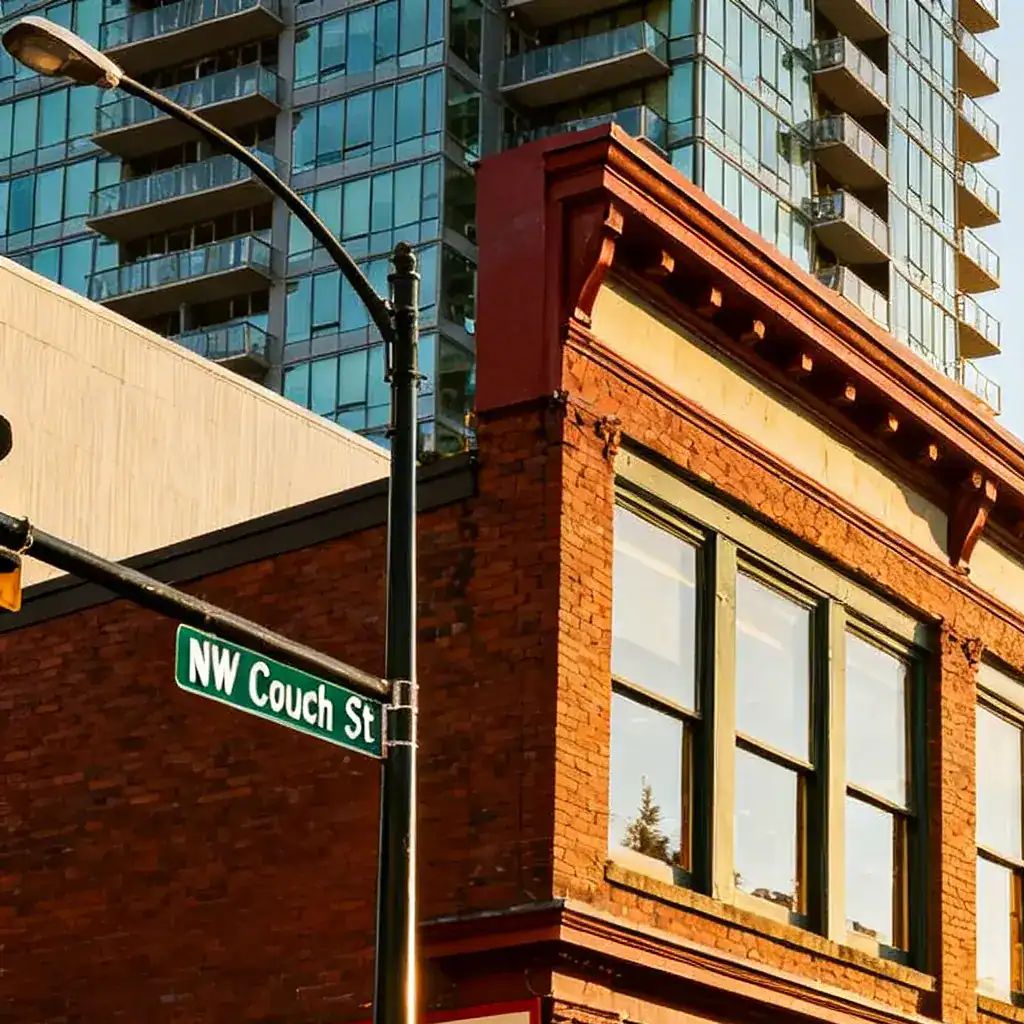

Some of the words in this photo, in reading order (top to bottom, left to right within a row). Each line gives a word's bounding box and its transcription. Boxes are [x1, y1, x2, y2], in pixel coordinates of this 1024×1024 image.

[189, 637, 240, 696] NW
[249, 661, 333, 732] Couch
[344, 696, 376, 743] St
